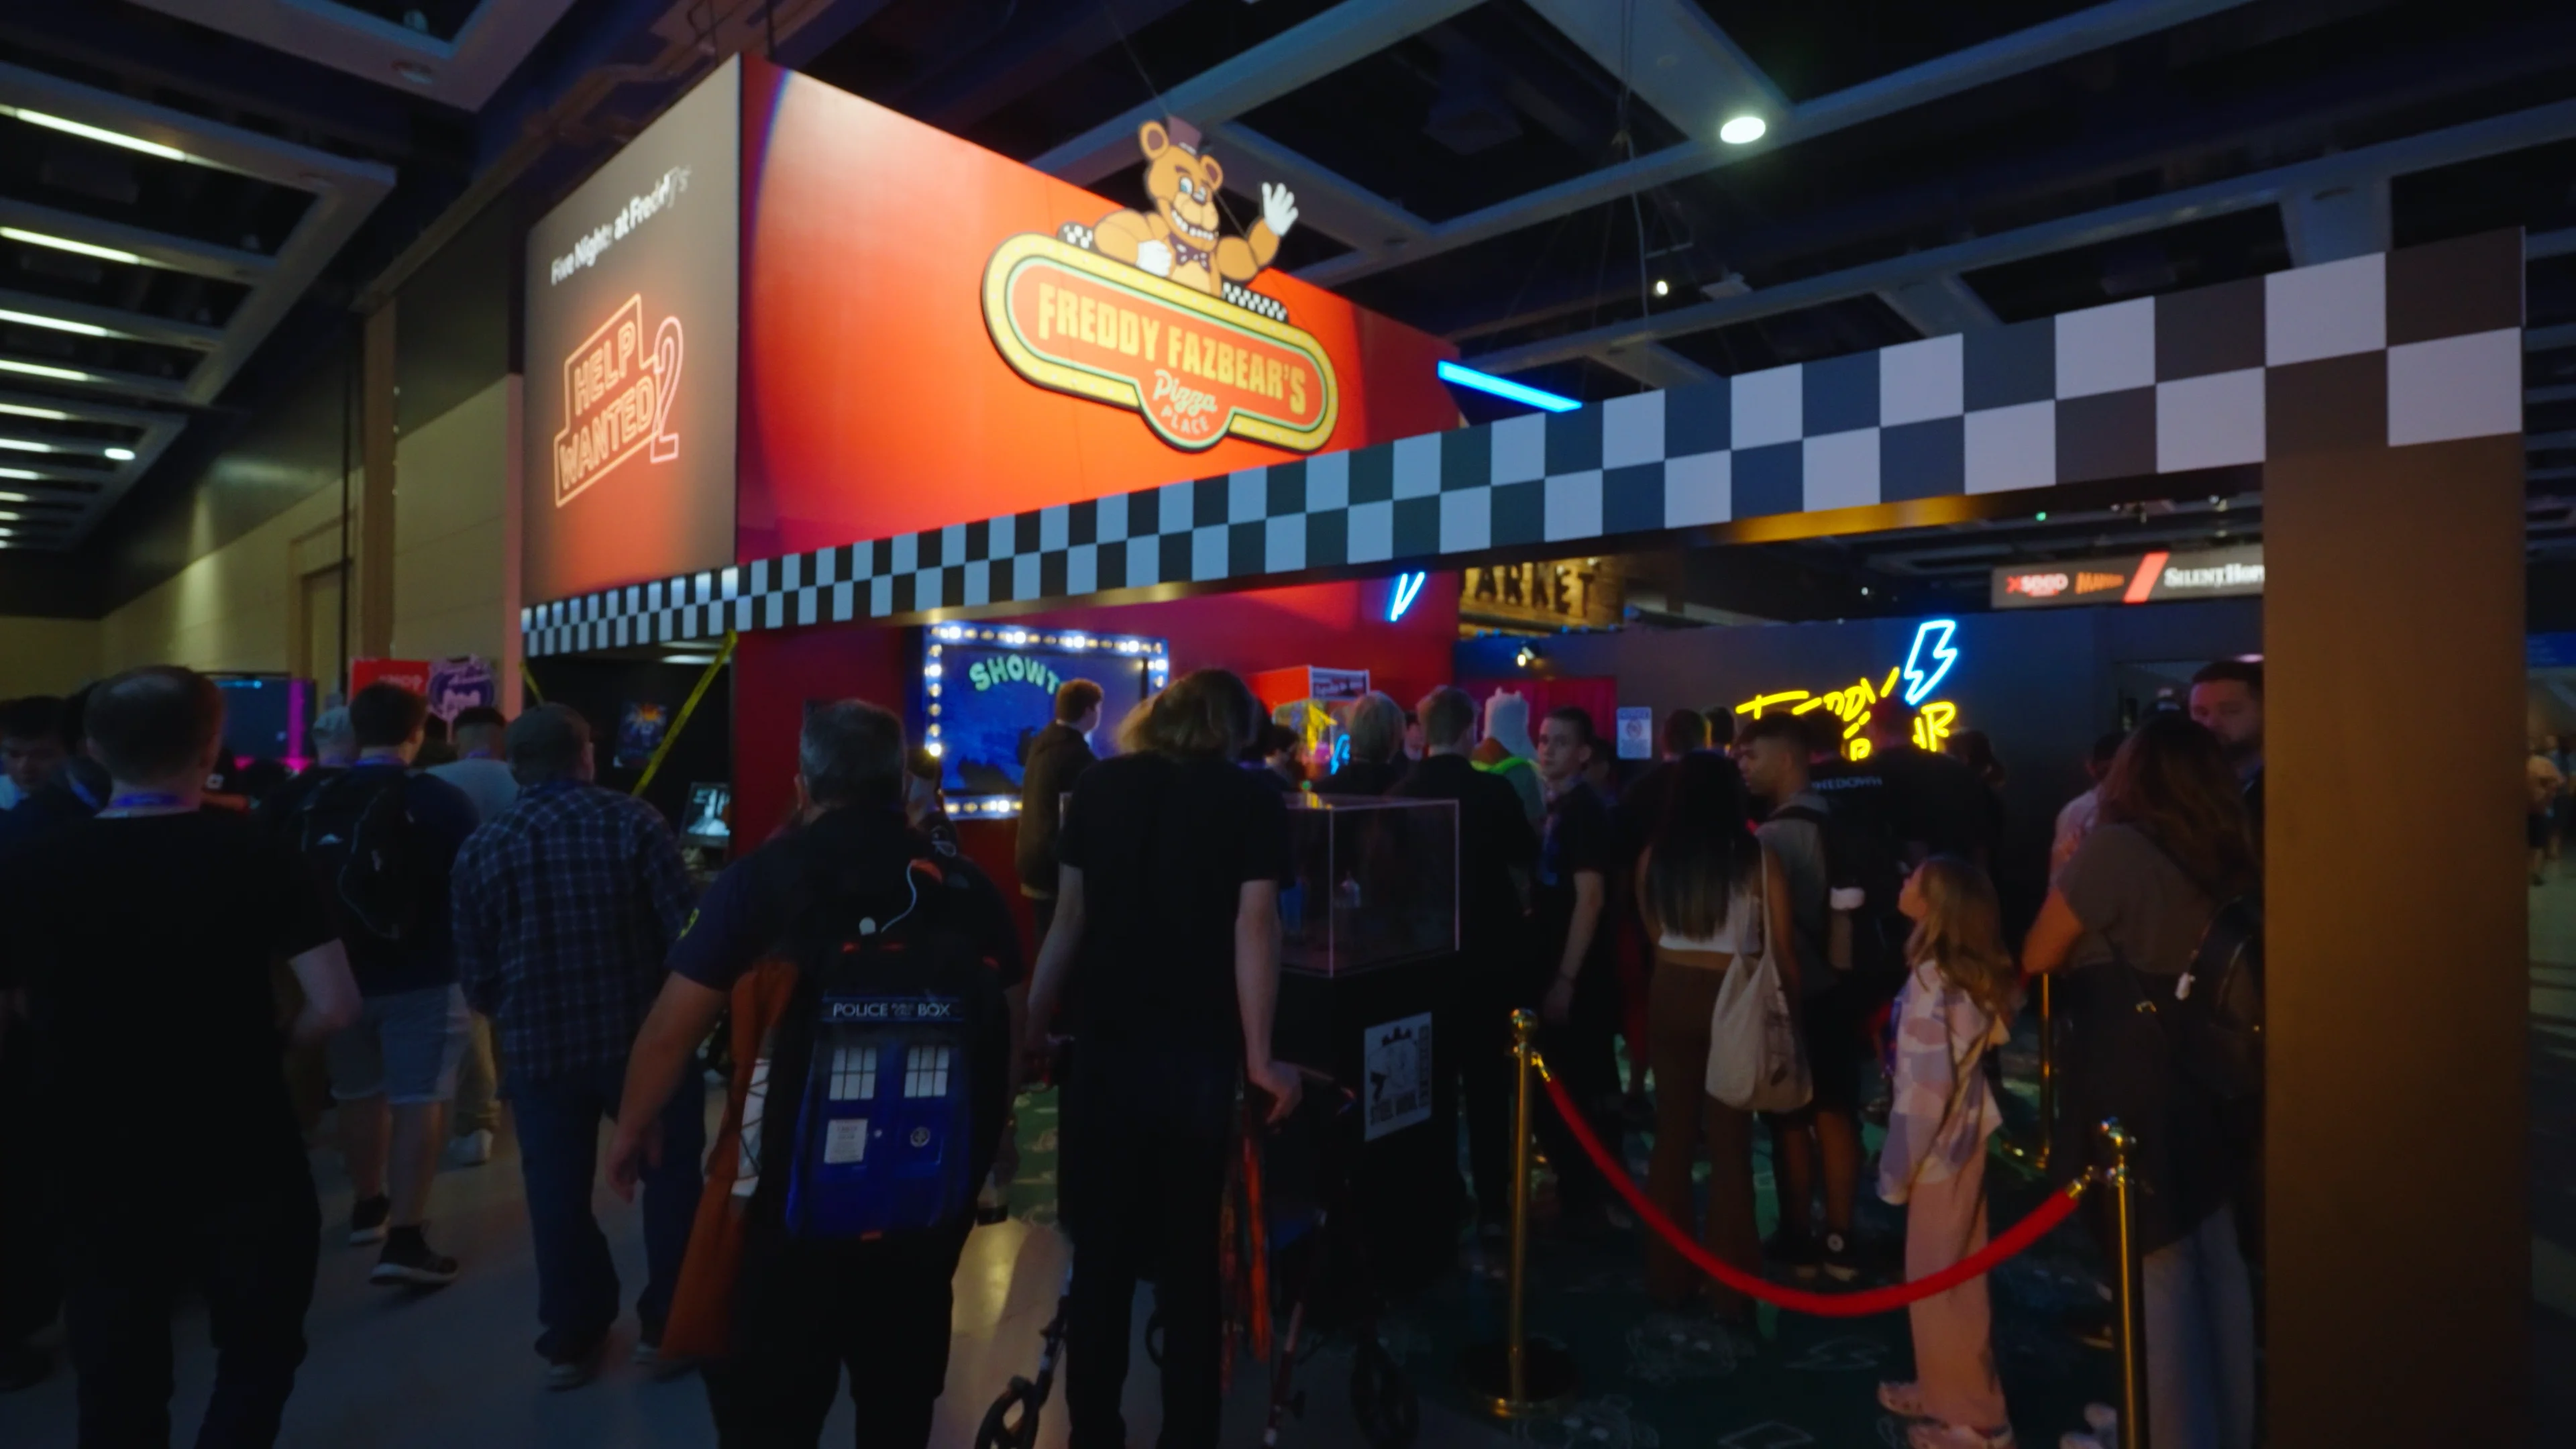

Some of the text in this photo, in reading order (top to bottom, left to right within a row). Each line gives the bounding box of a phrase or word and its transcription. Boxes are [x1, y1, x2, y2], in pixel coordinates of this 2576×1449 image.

[551, 253, 574, 286] Five
[574, 223, 614, 269] Nights
[614, 207, 629, 240] at
[574, 320, 637, 417] HELP
[1038, 282, 1307, 415] FREDDY FAZBEAR'S
[559, 315, 684, 492] WANTED 2
[1152, 368, 1218, 417] Pizza
[1161, 404, 1209, 435] PLACE
[1461, 562, 1596, 619] ARKET
[833, 1002, 888, 1018] POLICE
[918, 1003, 951, 1017] BOX
